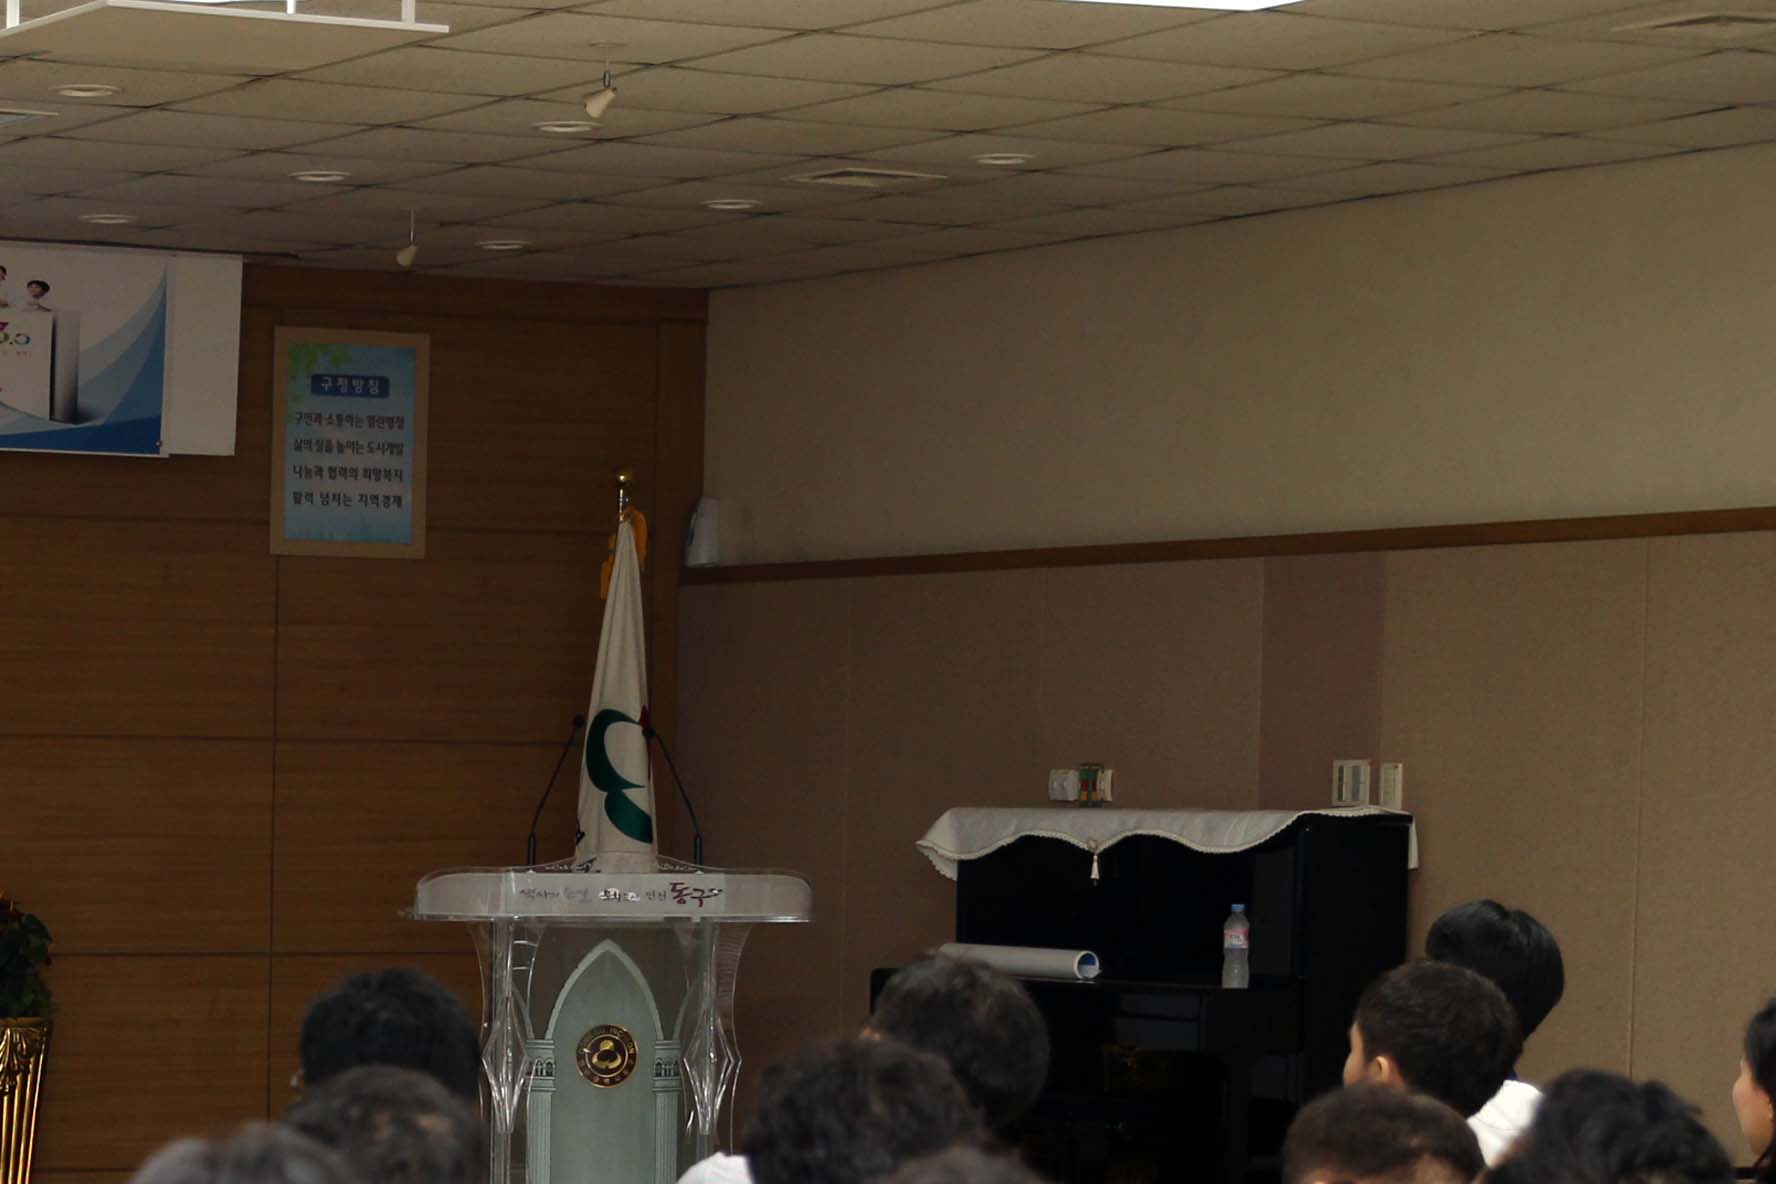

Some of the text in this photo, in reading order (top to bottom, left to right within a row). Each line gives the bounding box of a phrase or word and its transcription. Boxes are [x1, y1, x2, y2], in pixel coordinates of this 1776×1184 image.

[321, 376, 380, 395] 구정방침
[295, 411, 405, 430] 구민과 소통하는 열린행정
[294, 437, 404, 456] 삶의 질을 높이는 도시개발
[293, 464, 403, 482] 나눔과 협력의 희망복지
[292, 491, 314, 505] 활력
[319, 492, 352, 507] 넘치는
[669, 882, 723, 908] 동구
